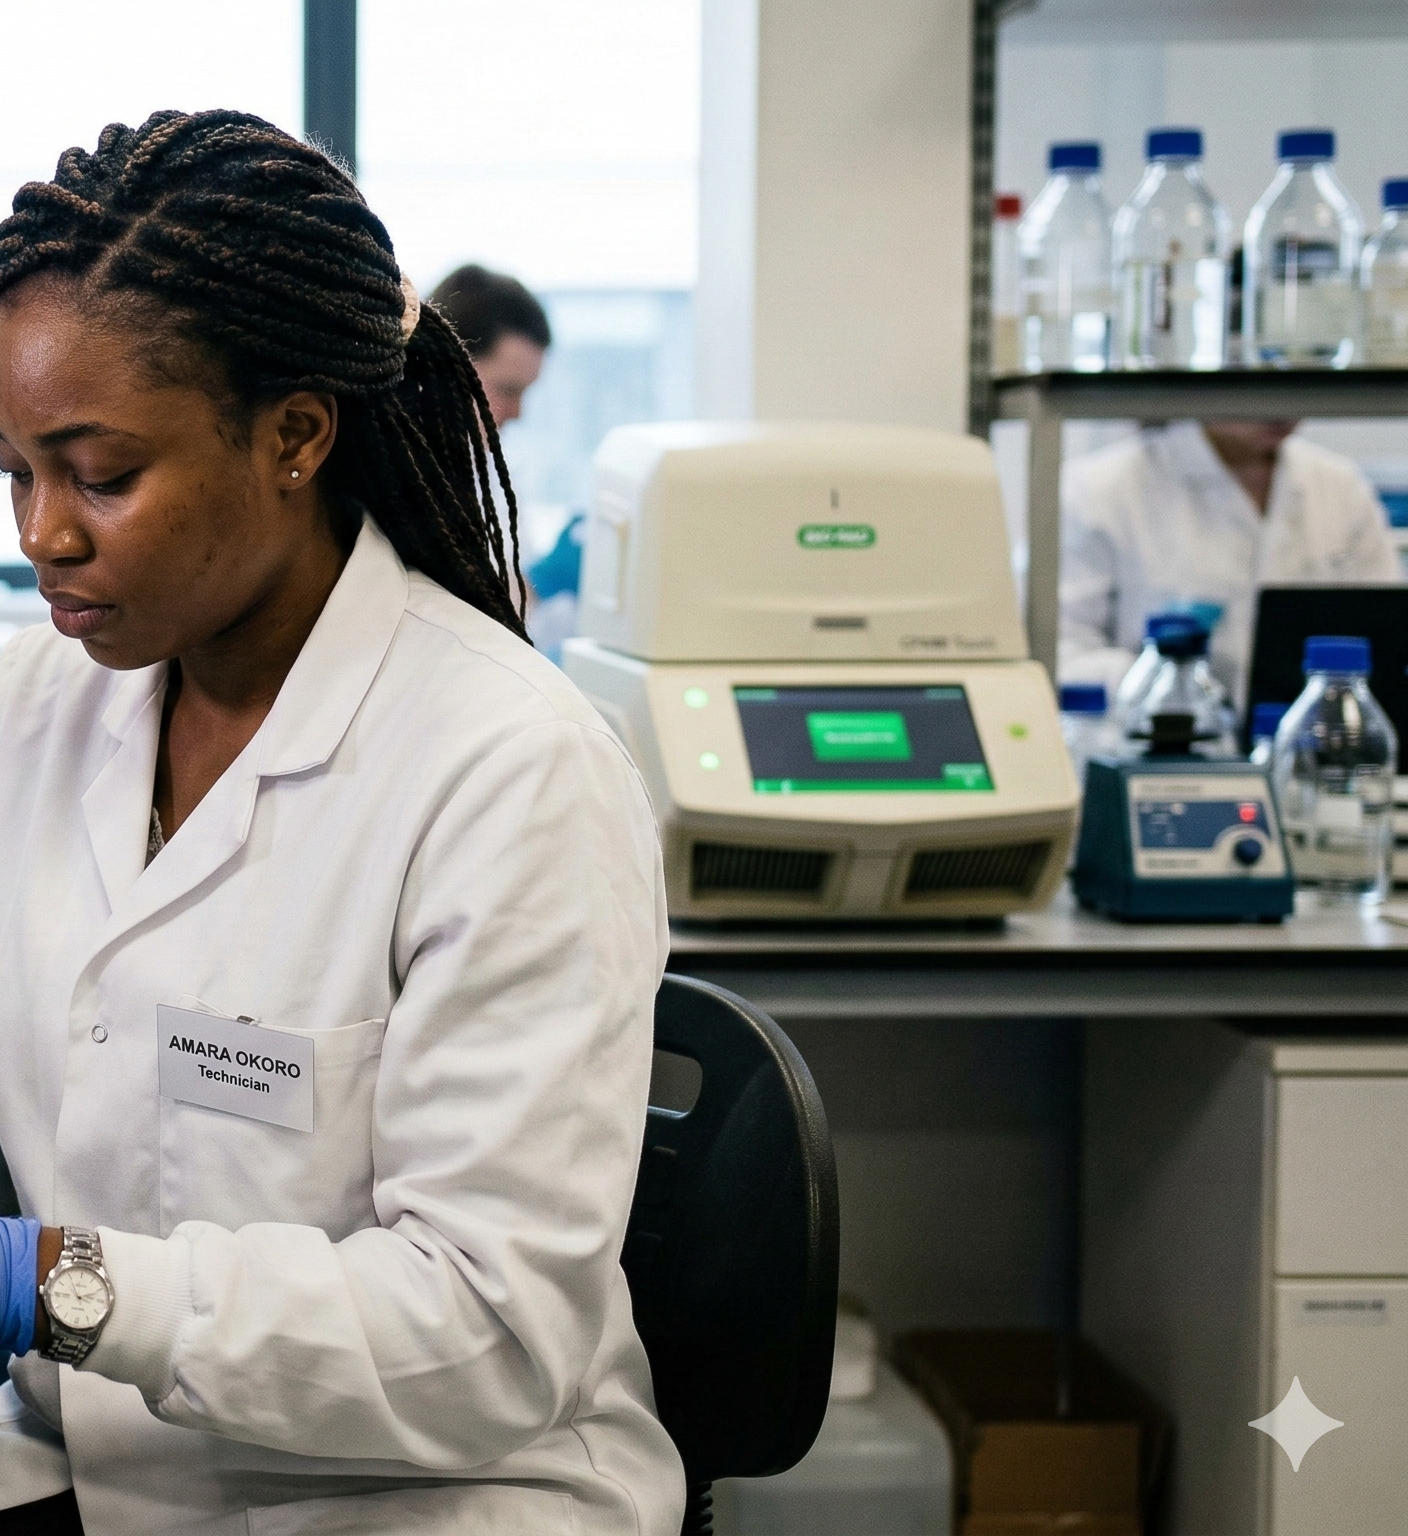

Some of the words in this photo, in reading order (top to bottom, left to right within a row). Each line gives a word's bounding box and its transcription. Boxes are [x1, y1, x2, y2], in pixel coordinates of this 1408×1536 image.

[169, 1035, 232, 1063] AMARA
[236, 1051, 301, 1079] OKORO
[198, 1064, 270, 1093] Technician
